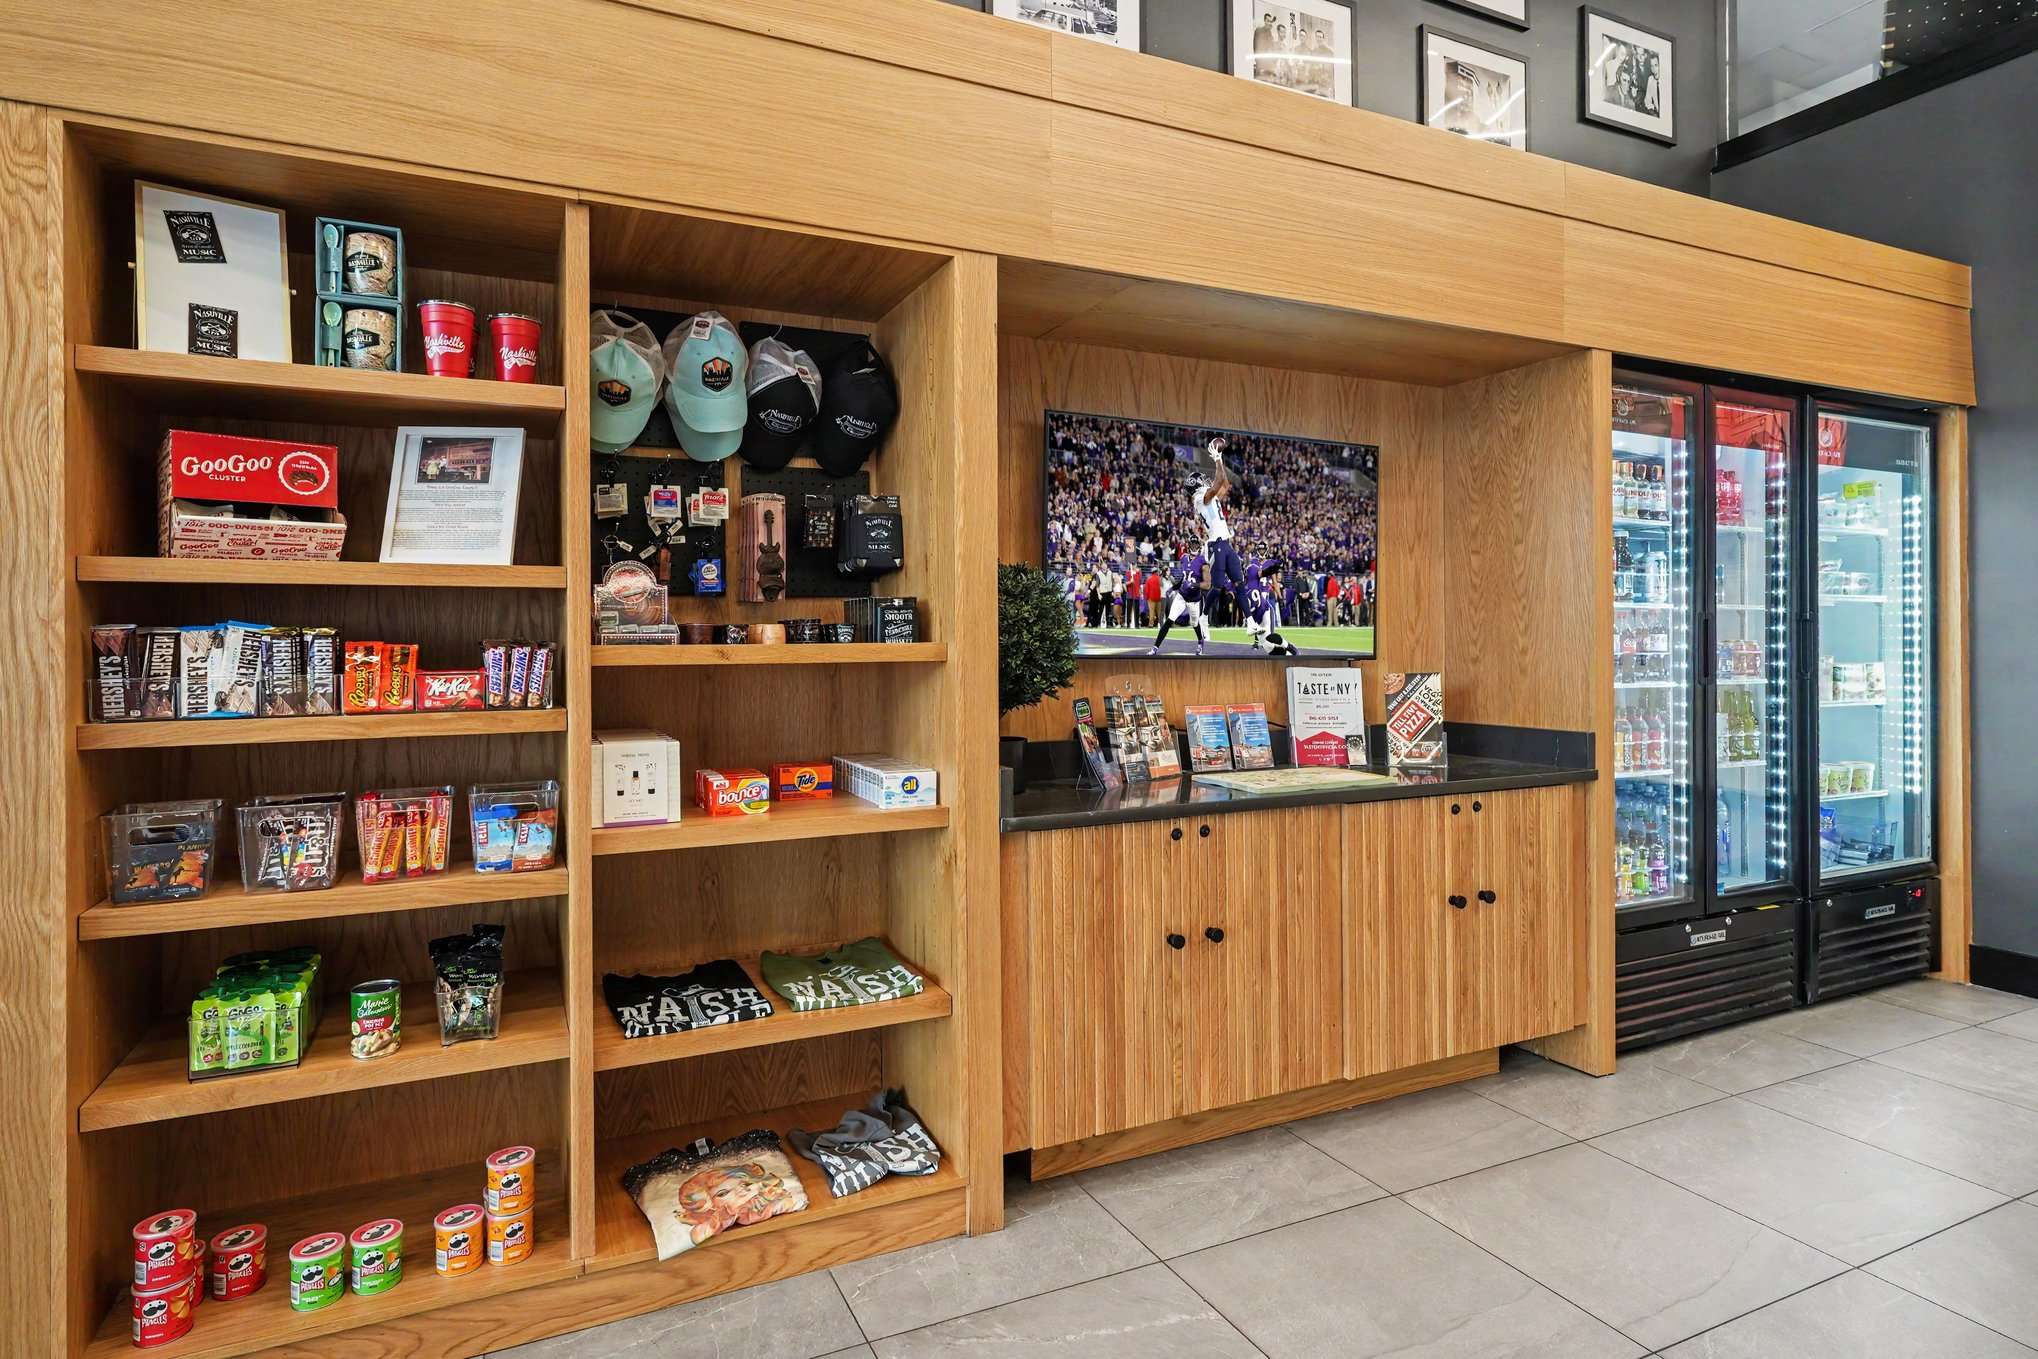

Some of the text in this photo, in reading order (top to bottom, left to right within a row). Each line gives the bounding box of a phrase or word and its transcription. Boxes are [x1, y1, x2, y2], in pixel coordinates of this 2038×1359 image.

[170, 215, 211, 228] NASHVILLE
[183, 248, 217, 256] MUSIC
[193, 309, 235, 326] NASHVILLE
[196, 341, 232, 353] MUSIC
[423, 334, 466, 350] Nashville
[208, 474, 246, 482] CLUSTER
[148, 634, 175, 692] HERSHEY'S
[235, 629, 262, 689] HERSHEY'S
[272, 638, 292, 695] HERSHEY'S
[313, 637, 333, 695] HERSHEY'S
[489, 649, 503, 694] SNICKERS
[511, 648, 528, 692] SNICKERS
[98, 655, 126, 718] HERSHEY'S
[186, 655, 209, 714] HERSHEY'S
[1297, 682, 1329, 695] TASTE
[1336, 683, 1350, 695] NY
[1392, 704, 1419, 730] TILL FIVE
[1399, 710, 1427, 738] PIZZA
[796, 774, 816, 787] Tide
[904, 779, 916, 791] all
[718, 785, 761, 805] bounce
[360, 998, 389, 1010] Marie
